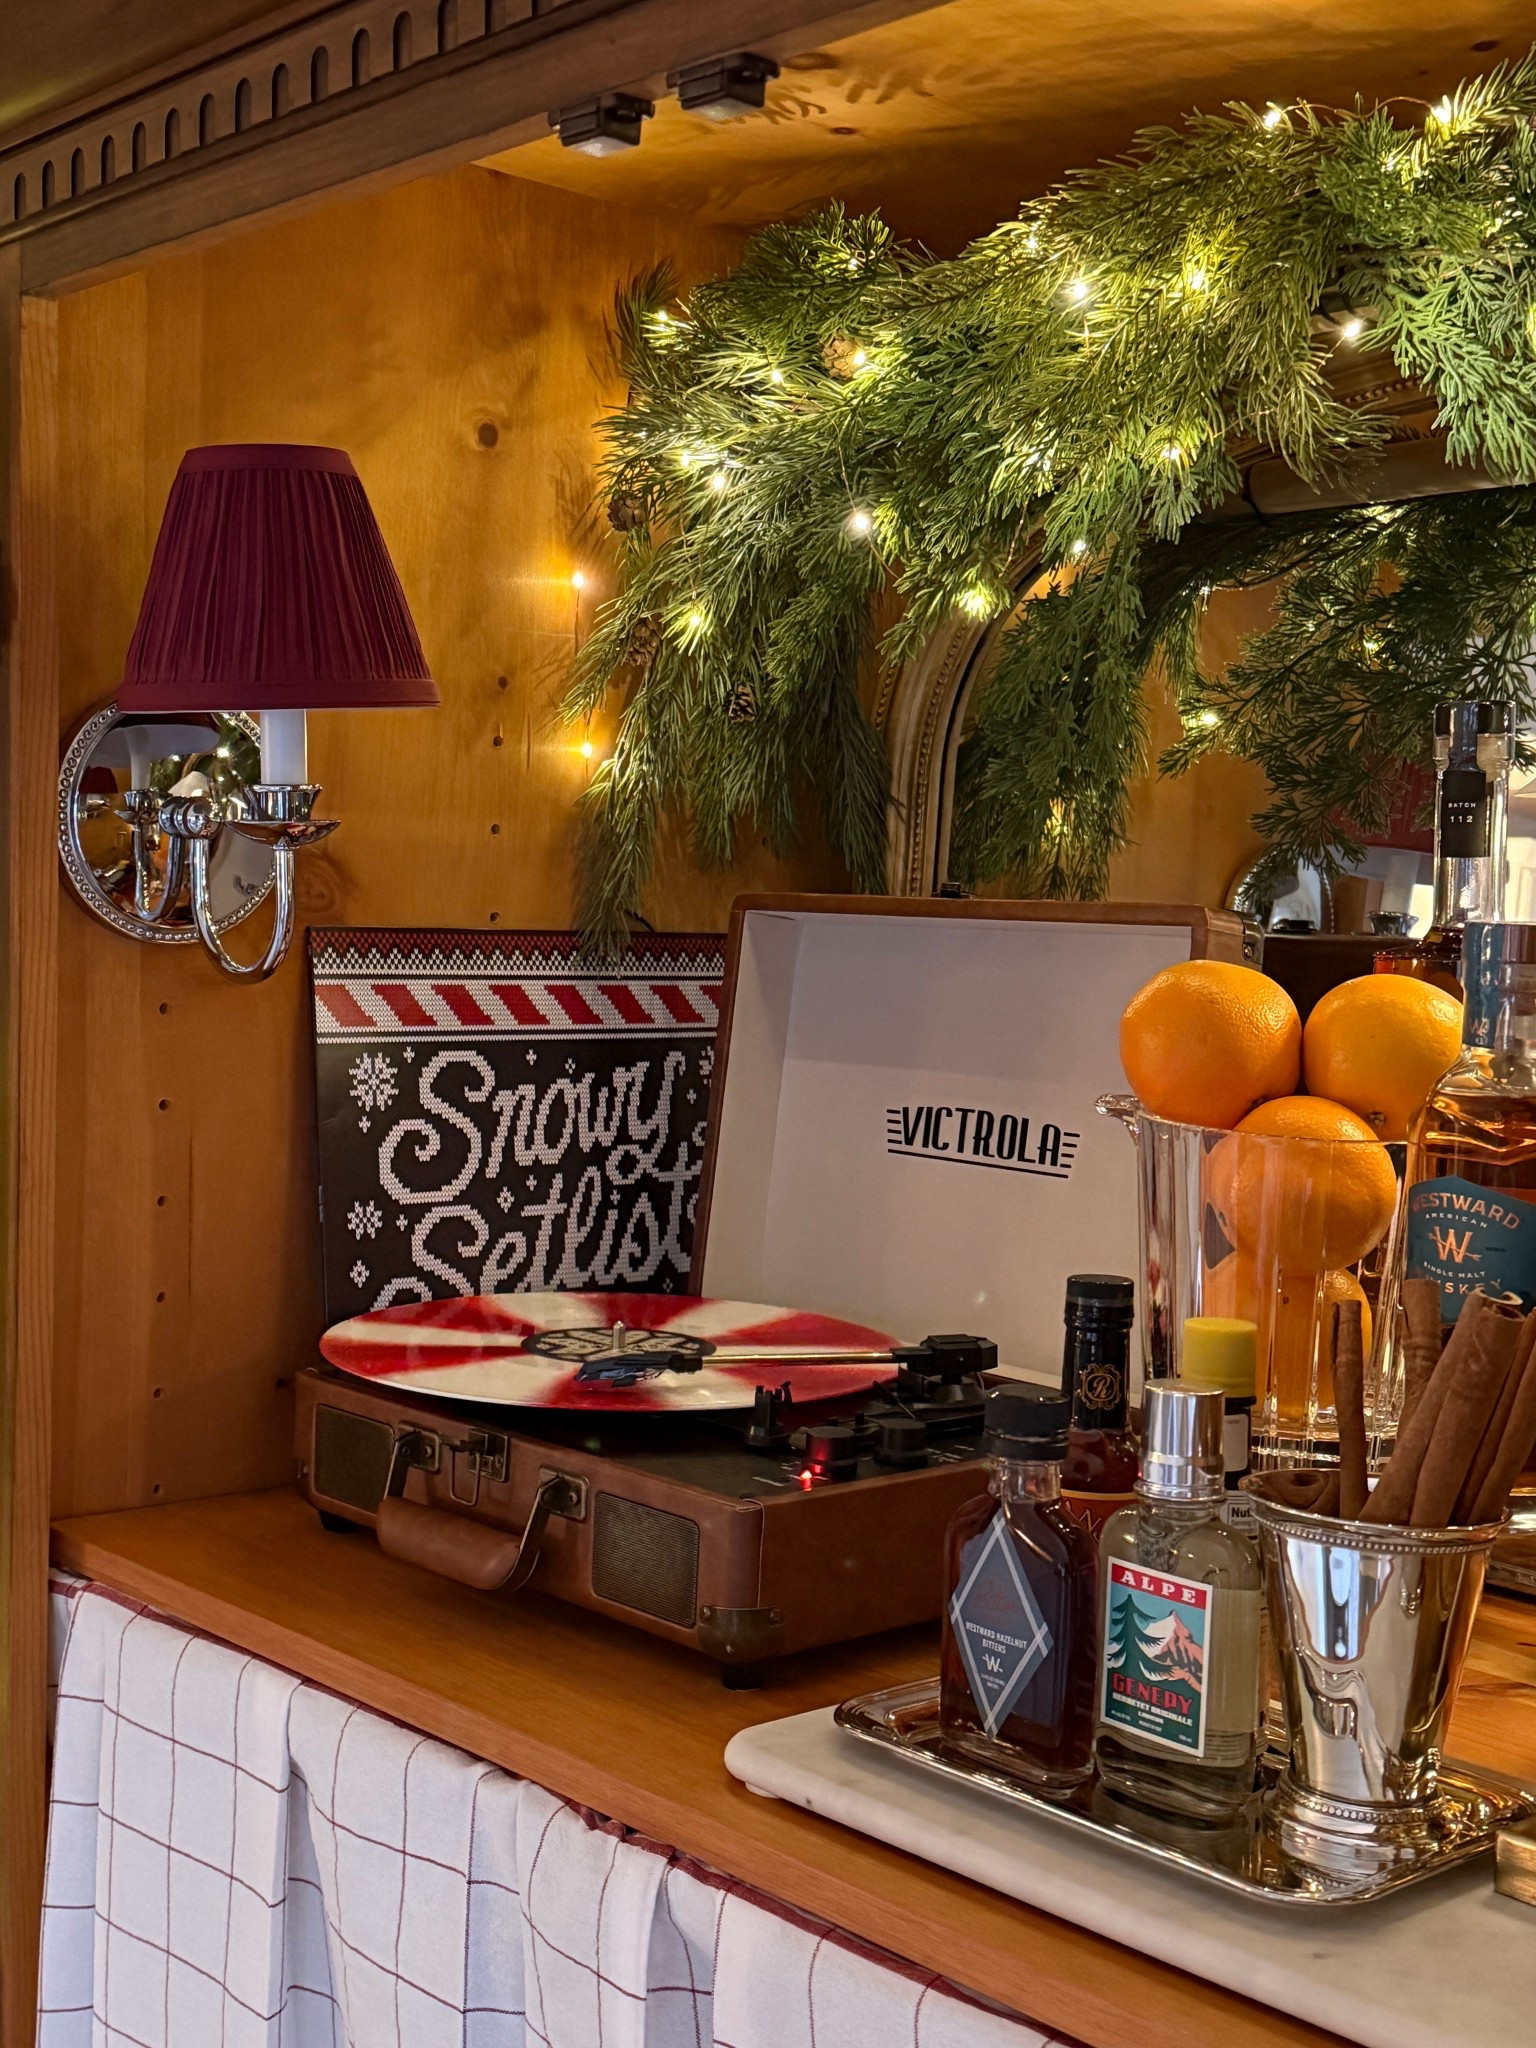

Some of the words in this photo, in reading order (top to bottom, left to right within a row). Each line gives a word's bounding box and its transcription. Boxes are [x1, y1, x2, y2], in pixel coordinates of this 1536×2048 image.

[1449, 815, 1474, 823] 112
[378, 1050, 687, 1204] Snowy
[902, 1106, 1062, 1167] VICTROLA
[370, 1141, 702, 1312] Setlist
[1412, 1192, 1521, 1230] WESTWARD
[1425, 1212, 1488, 1228] AMERICAN
[1423, 1261, 1454, 1277] SINGLE
[1458, 1271, 1486, 1279] MALT
[1120, 1570, 1196, 1603] ALPE
[965, 1620, 996, 1639] WESTWARD
[996, 1632, 1028, 1649] HAZELNUT
[981, 1638, 1007, 1654] BITTERS
[1112, 1672, 1193, 1715] GENEPY
